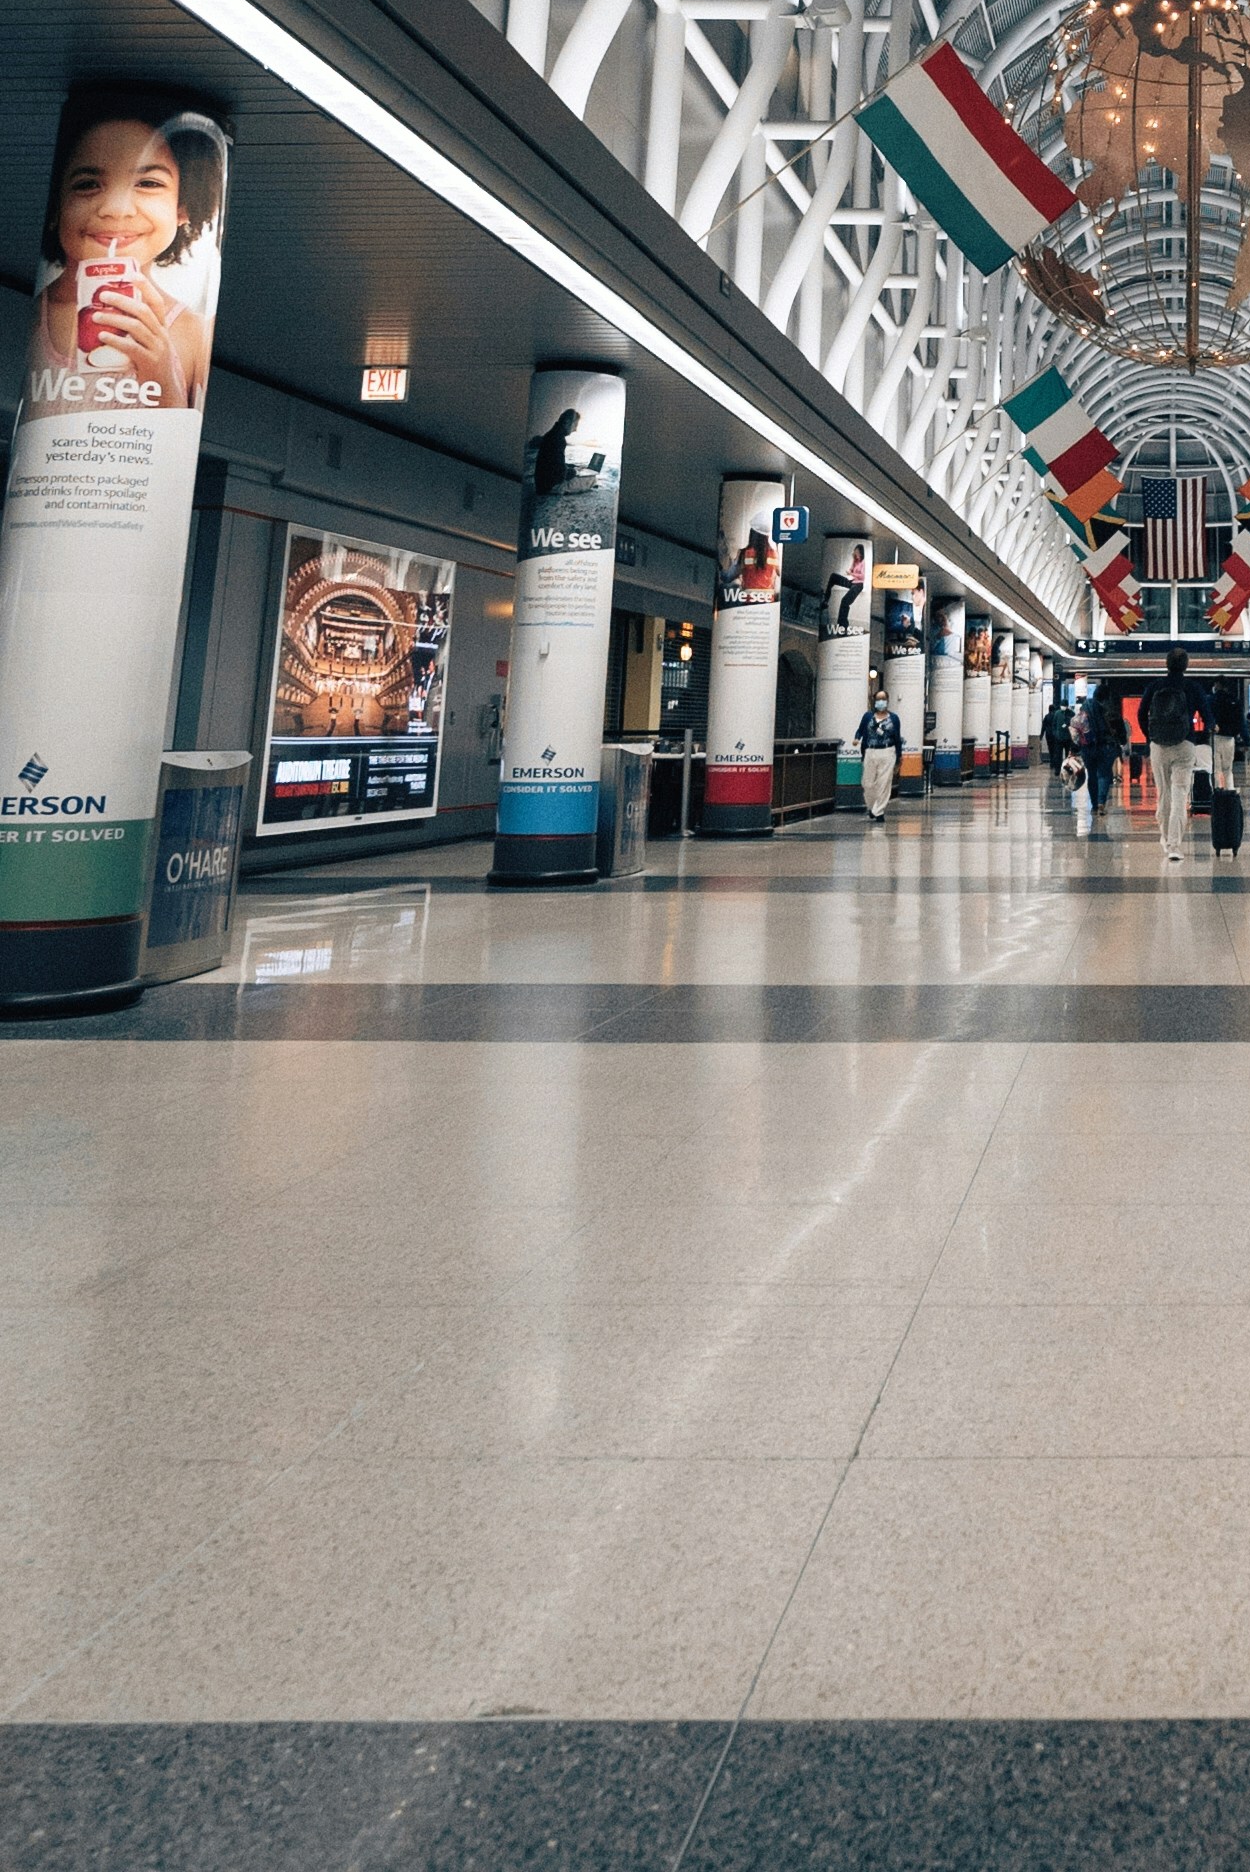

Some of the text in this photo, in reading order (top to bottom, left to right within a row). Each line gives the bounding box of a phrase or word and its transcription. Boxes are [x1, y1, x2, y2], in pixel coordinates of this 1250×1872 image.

[92, 266, 119, 275] Apple
[31, 368, 162, 407] We see
[368, 369, 401, 392] EXIT
[88, 423, 154, 439] food safety
[52, 438, 153, 454] scares becoming
[45, 452, 153, 466] yesterday's news.
[51, 474, 96, 486] protects
[97, 475, 149, 488] packaged
[24, 486, 40, 497] and
[41, 486, 72, 497] drinks
[74, 486, 102, 497] from
[104, 488, 148, 501] spoilage
[45, 499, 149, 513] and contamination.
[531, 528, 602, 549] We see
[724, 588, 772, 603] We see
[827, 624, 864, 636] We see
[892, 646, 907, 655] We
[715, 754, 764, 763] EMERSON
[512, 767, 584, 778] EMERSON
[503, 785, 592, 793] CONSIDER IT SOLVED
[0, 795, 106, 815] ERSON
[0, 828, 125, 843] ER IT SOLVED
[167, 846, 229, 883] O'HARE
